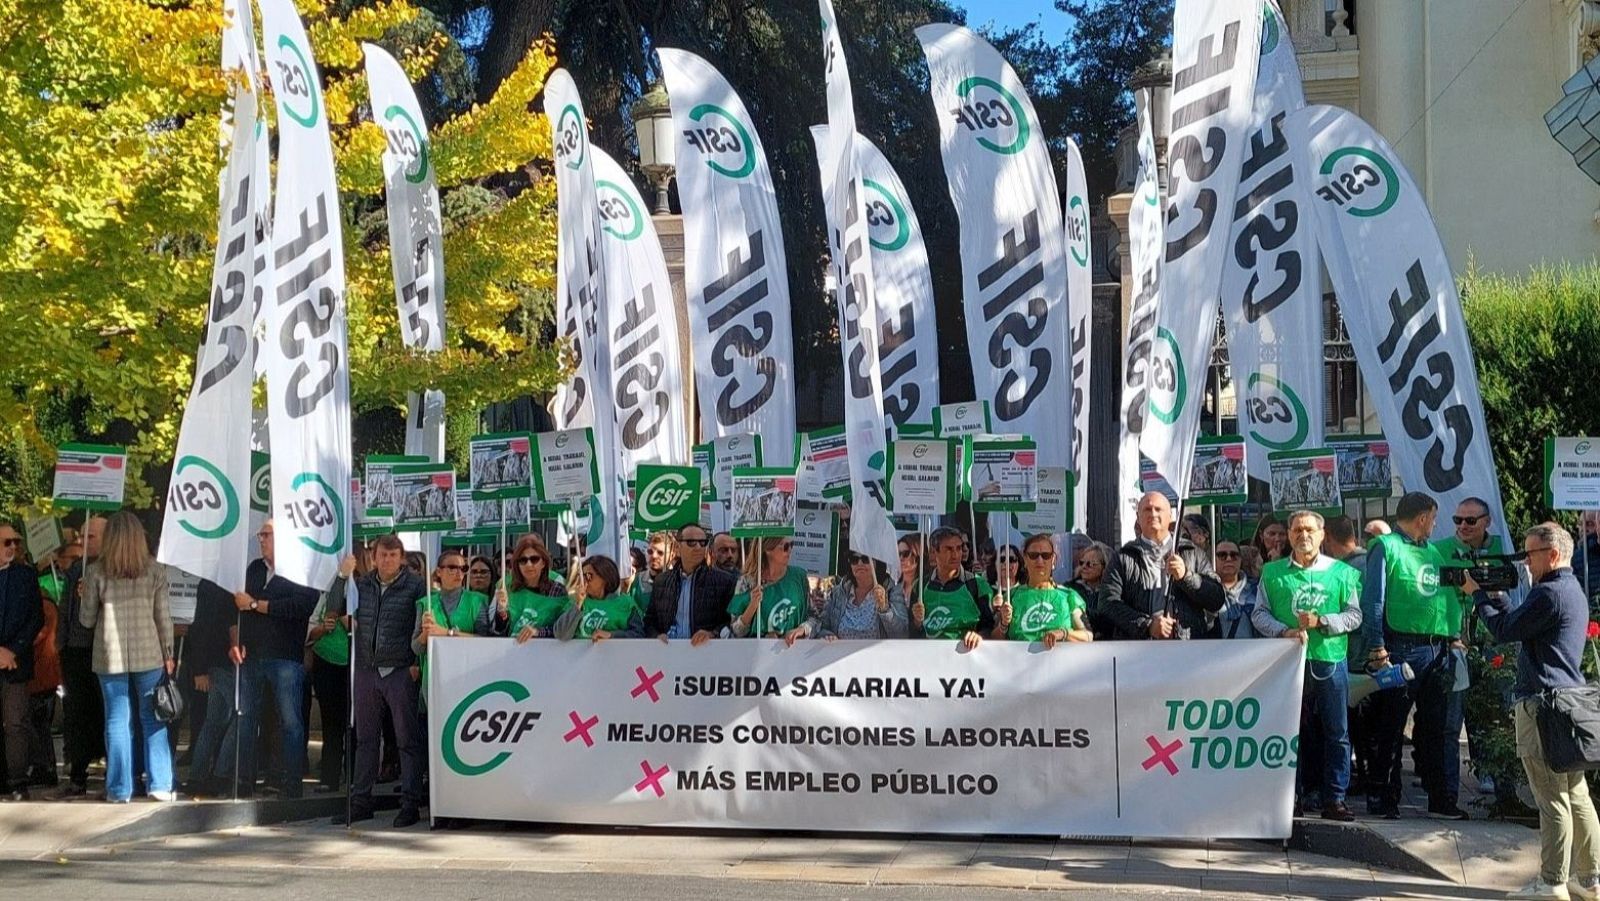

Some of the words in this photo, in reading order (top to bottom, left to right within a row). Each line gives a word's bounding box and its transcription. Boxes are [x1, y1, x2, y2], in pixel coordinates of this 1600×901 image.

[649, 487, 693, 506] CSIF
[674, 676, 781, 698] ¡SUBIDA
[791, 677, 929, 699] SALARIAL
[938, 677, 986, 699] YA!
[460, 709, 542, 744] CSIF
[1165, 697, 1261, 731] TODO
[607, 723, 724, 743] MEJORES
[733, 725, 916, 747] CONDICIONES
[925, 727, 1091, 749] LABORALES
[677, 765, 736, 792] MÁS
[746, 771, 861, 794] EMPLEO
[871, 768, 999, 795] PÚBLICO
